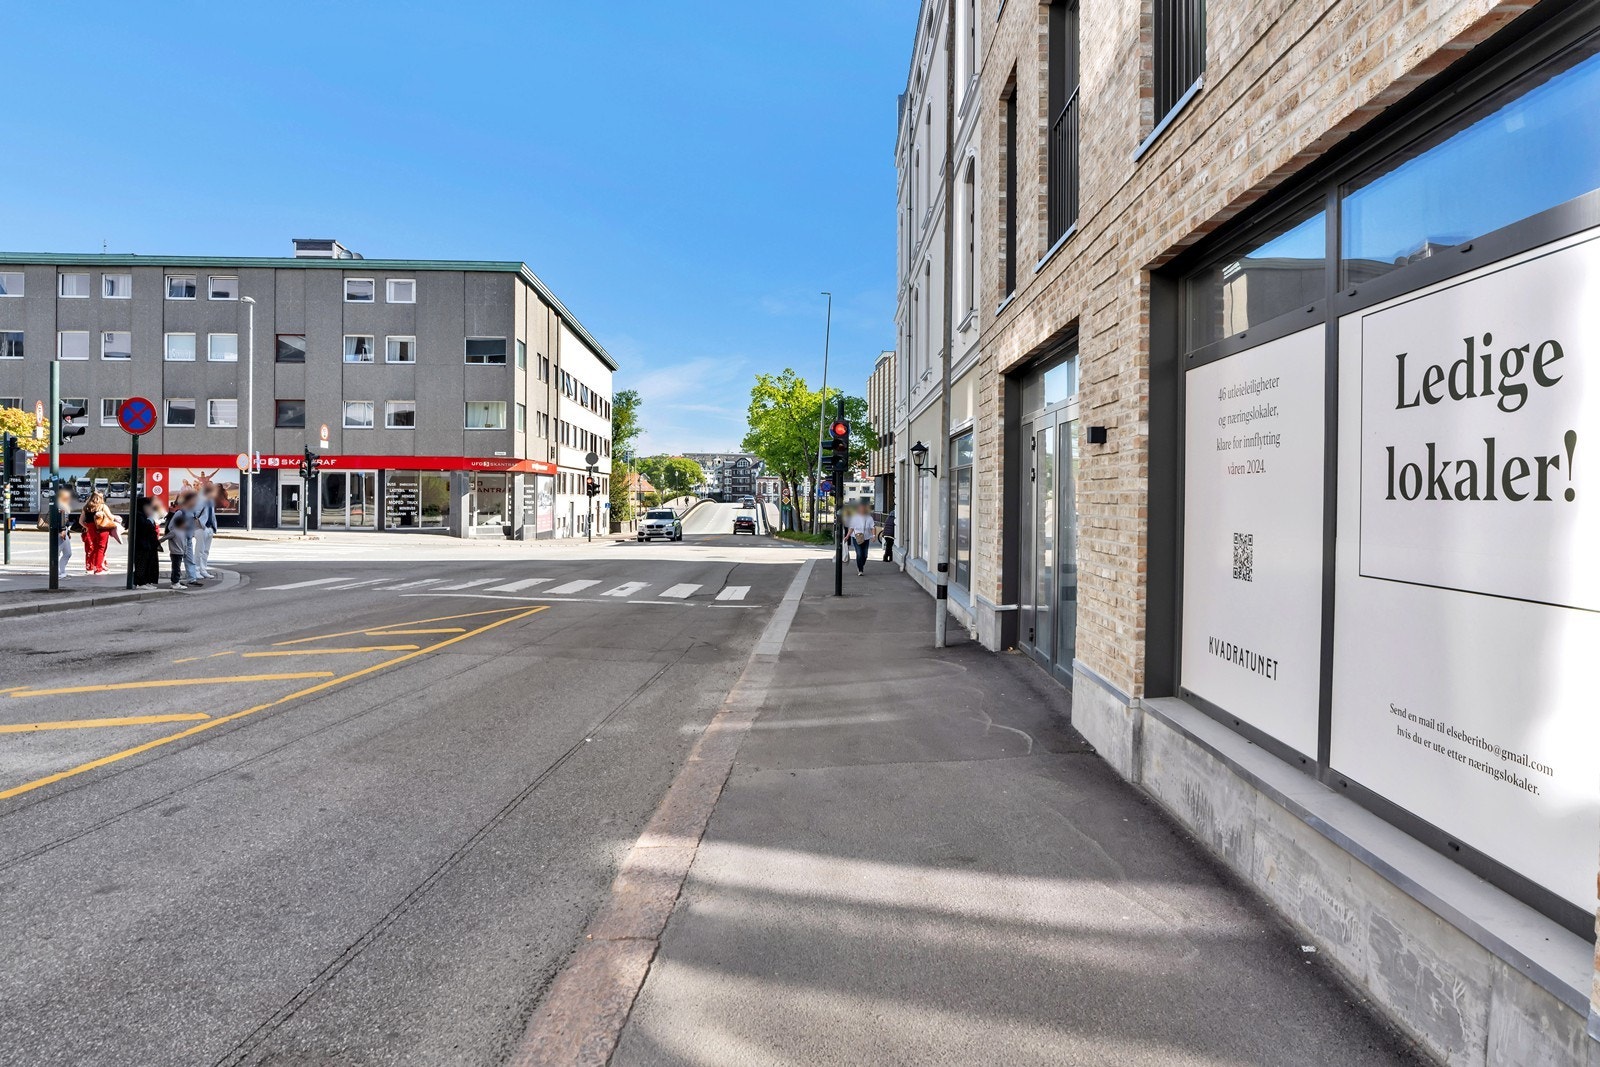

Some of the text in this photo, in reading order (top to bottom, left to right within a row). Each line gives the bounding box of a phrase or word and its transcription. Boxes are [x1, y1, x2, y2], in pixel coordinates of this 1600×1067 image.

[1218, 377, 1280, 401] 46 utleieleiligheter
[1395, 332, 1564, 412] Ledige
[1216, 432, 1281, 451] klare for innflytting
[1218, 416, 1227, 429] og
[1227, 459, 1267, 475] våren 2024.
[1385, 429, 1577, 502] lokaler!
[1208, 635, 1279, 681] KVADRATUNET
[1389, 702, 1554, 777] Send en mail til elseberitbo@gmail.com
[1396, 724, 1541, 796] hvis du er ute etter næringslokaler.
